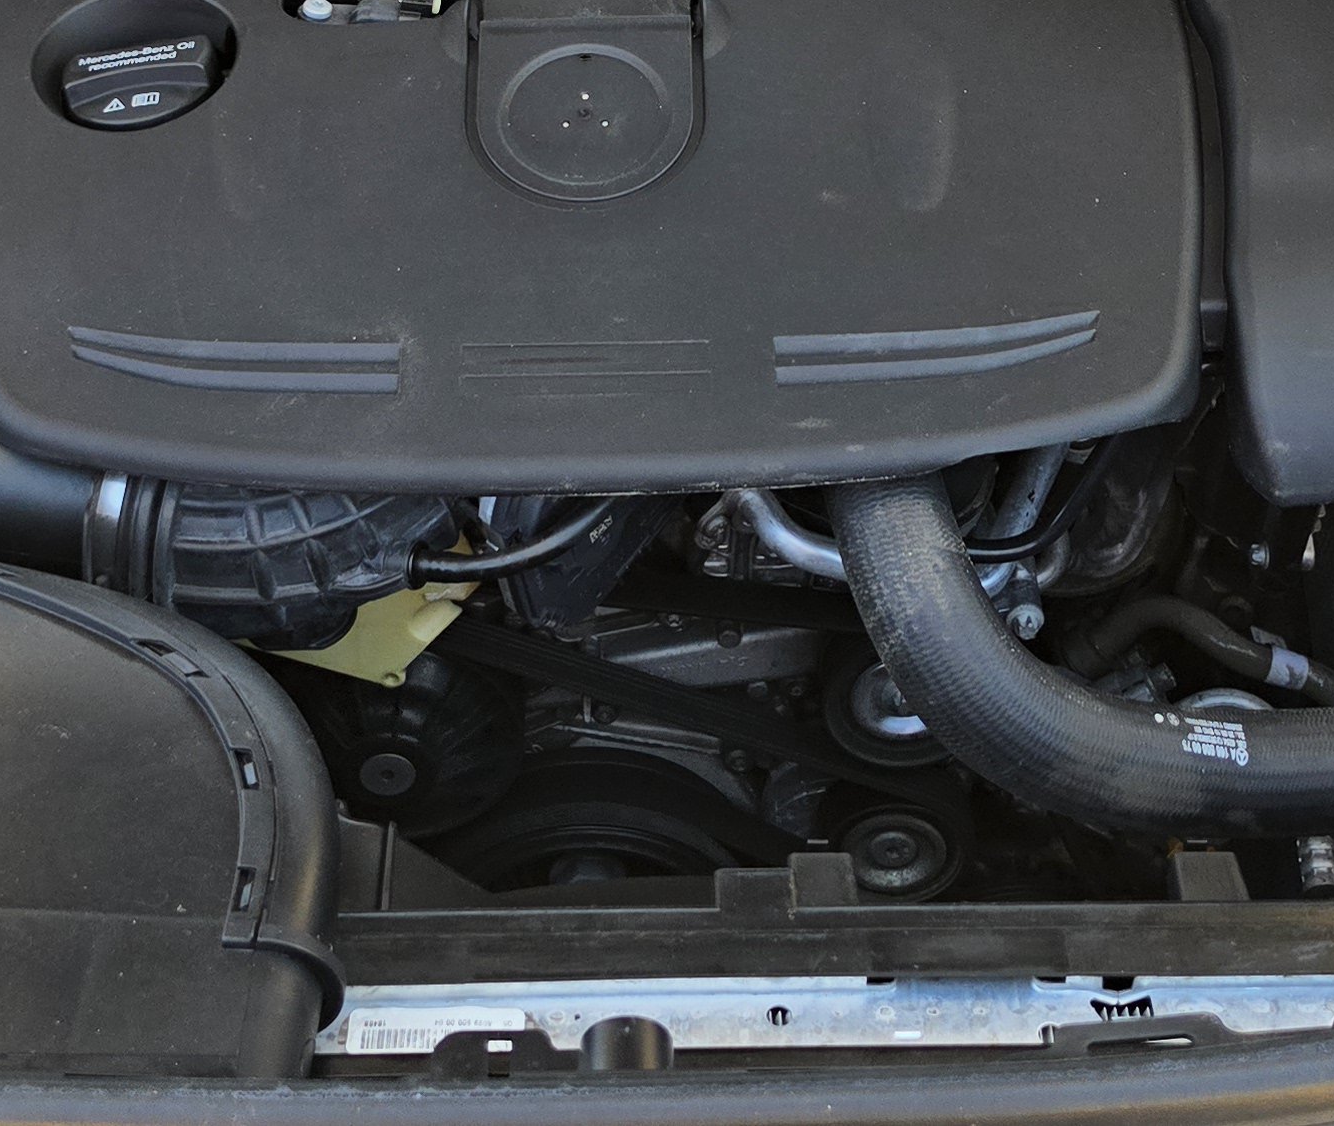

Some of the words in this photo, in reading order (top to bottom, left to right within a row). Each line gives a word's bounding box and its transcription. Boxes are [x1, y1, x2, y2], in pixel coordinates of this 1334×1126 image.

[78, 44, 175, 67] Mercedes-Benz
[176, 40, 196, 51] Oil
[88, 51, 177, 72] recommended
